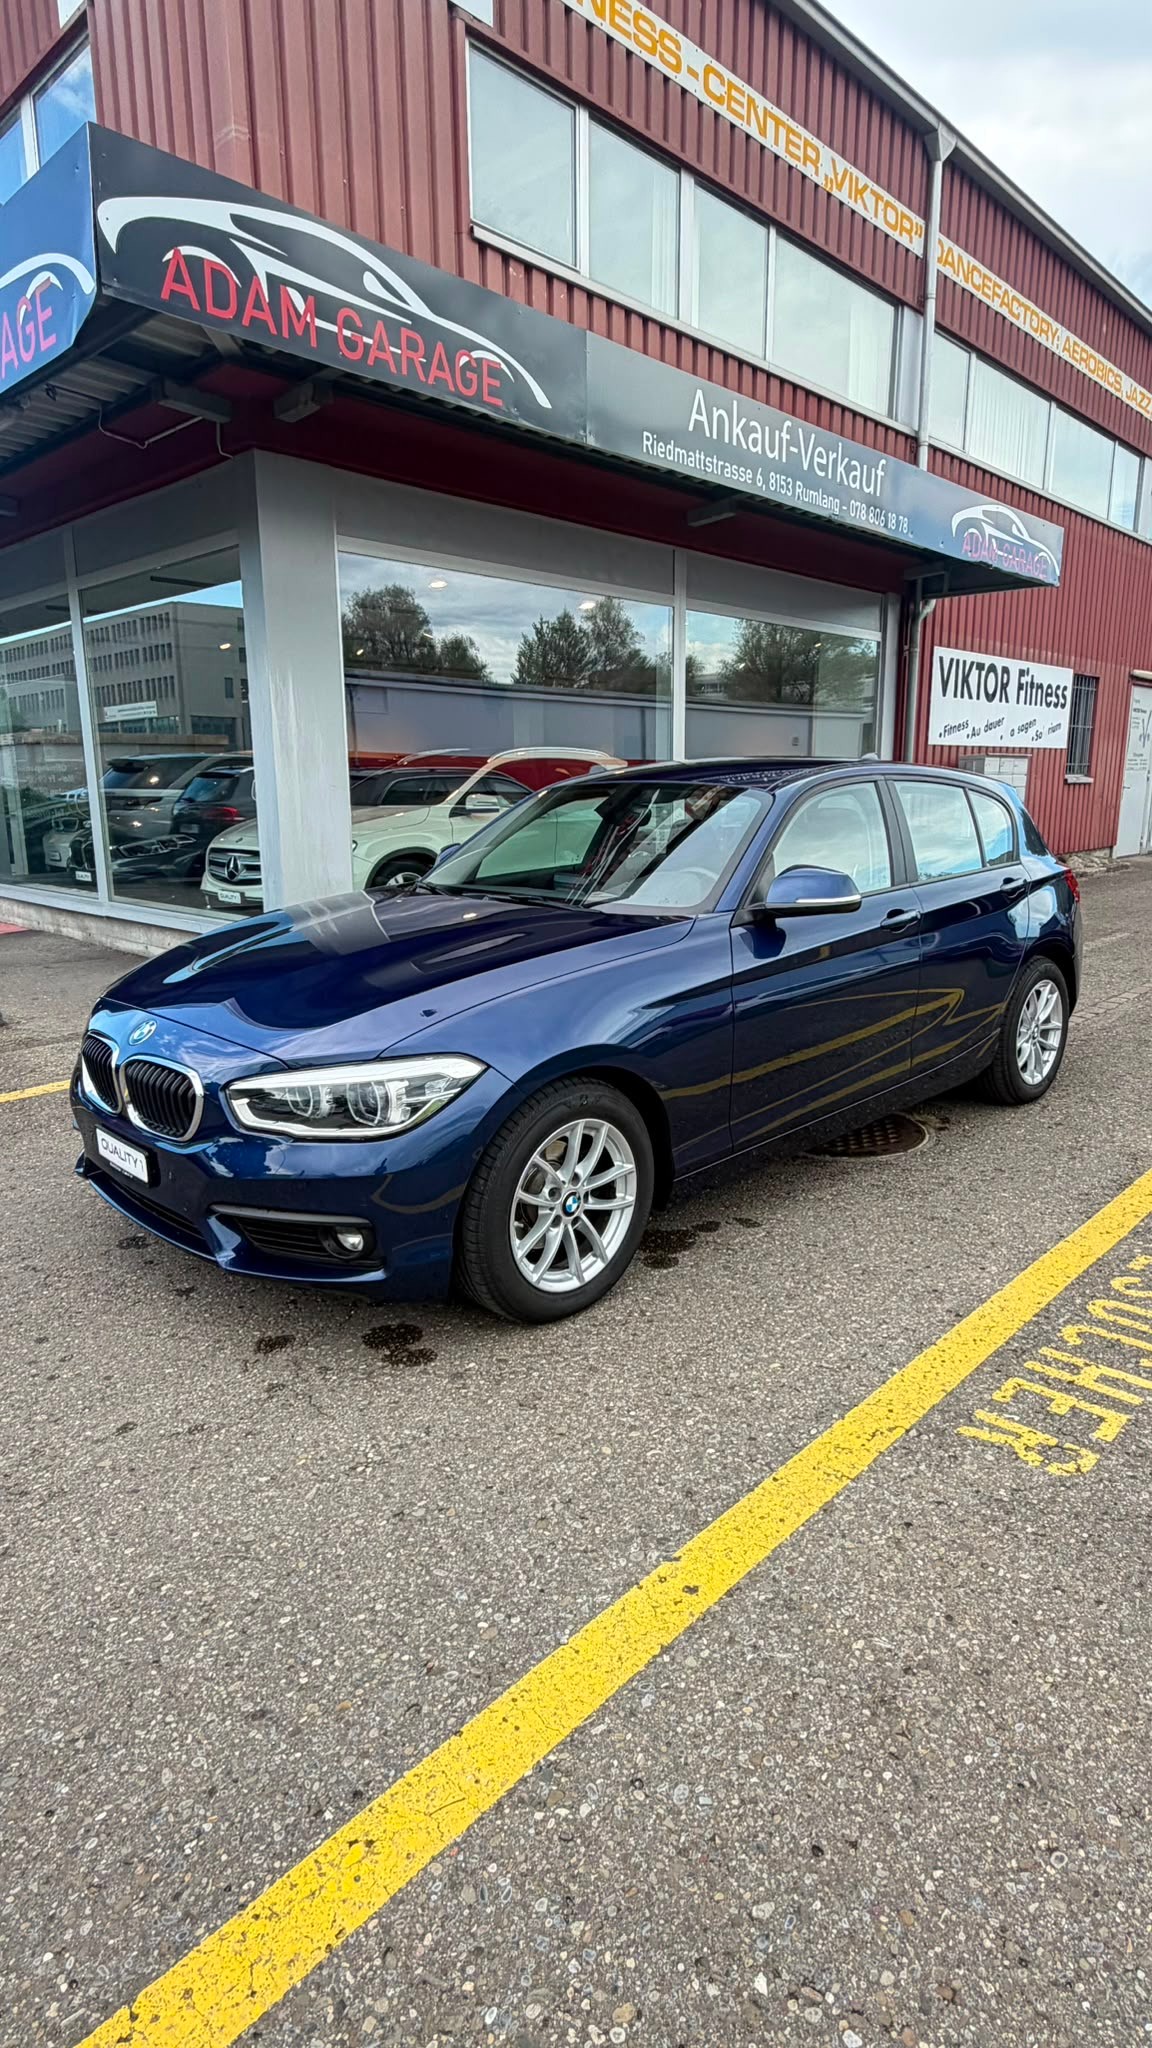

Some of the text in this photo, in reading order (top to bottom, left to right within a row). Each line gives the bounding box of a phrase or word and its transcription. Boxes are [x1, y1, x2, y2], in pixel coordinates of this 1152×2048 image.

[161, 247, 504, 407] ADAM GARAGE
[688, 388, 886, 497] Ankauf-Verkauf
[642, 431, 753, 484] Riedmattstrasse
[756, 467, 766, 491] 6,
[769, 473, 793, 497] 8153
[795, 480, 840, 515] Rumlang
[849, 499, 867, 522] 078
[868, 505, 886, 528] 806
[887, 510, 896, 530] 18
[898, 515, 908, 535] 78
[962, 532, 1047, 579] ADAM GARAGE
[938, 655, 1068, 710] VIKTOR Fitness
[942, 719, 969, 738] Fitness
[101, 1137, 138, 1169] QUALITY
[957, 1254, 1152, 1475] UCHER
